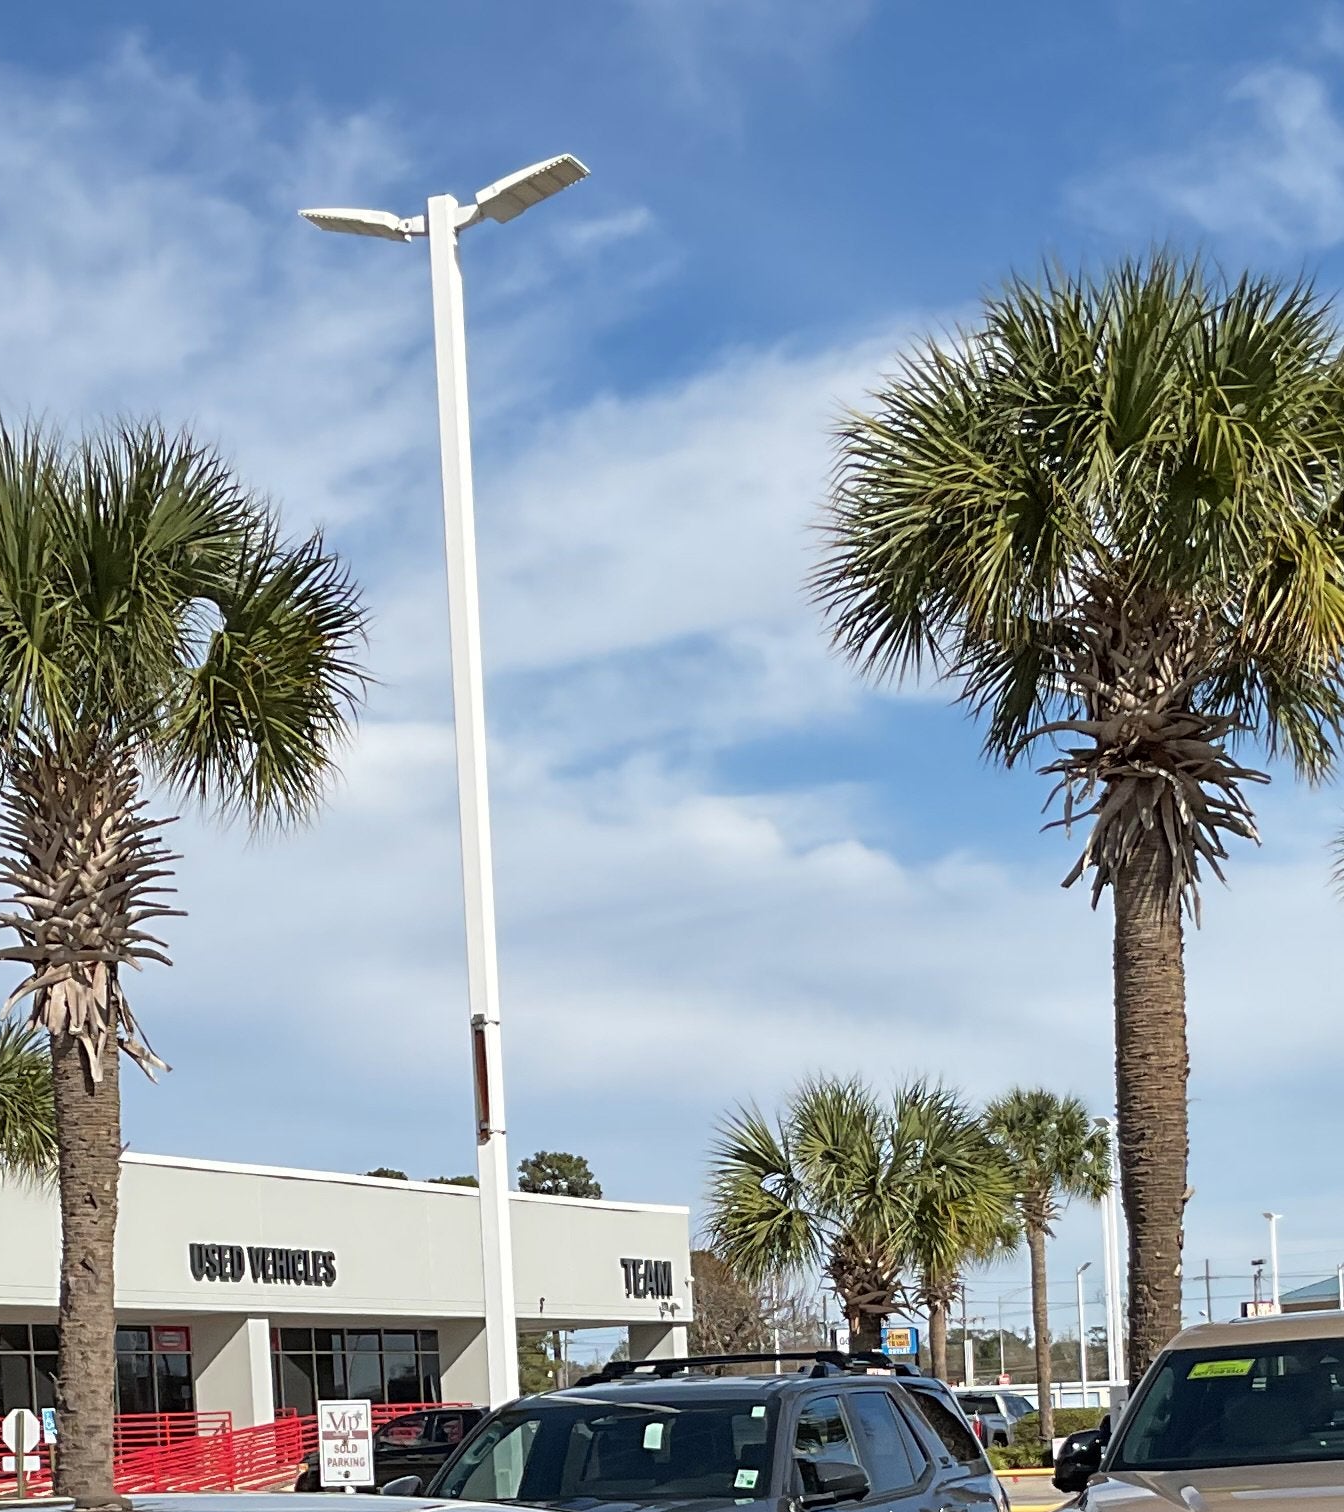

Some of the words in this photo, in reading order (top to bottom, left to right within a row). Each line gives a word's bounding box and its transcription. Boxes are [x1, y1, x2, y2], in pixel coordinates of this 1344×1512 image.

[189, 1243, 245, 1282] USED
[246, 1246, 337, 1287] VEHICLES
[619, 1257, 674, 1299] TEAM
[334, 1444, 358, 1453] SOLD
[327, 1457, 365, 1467] PARKING
